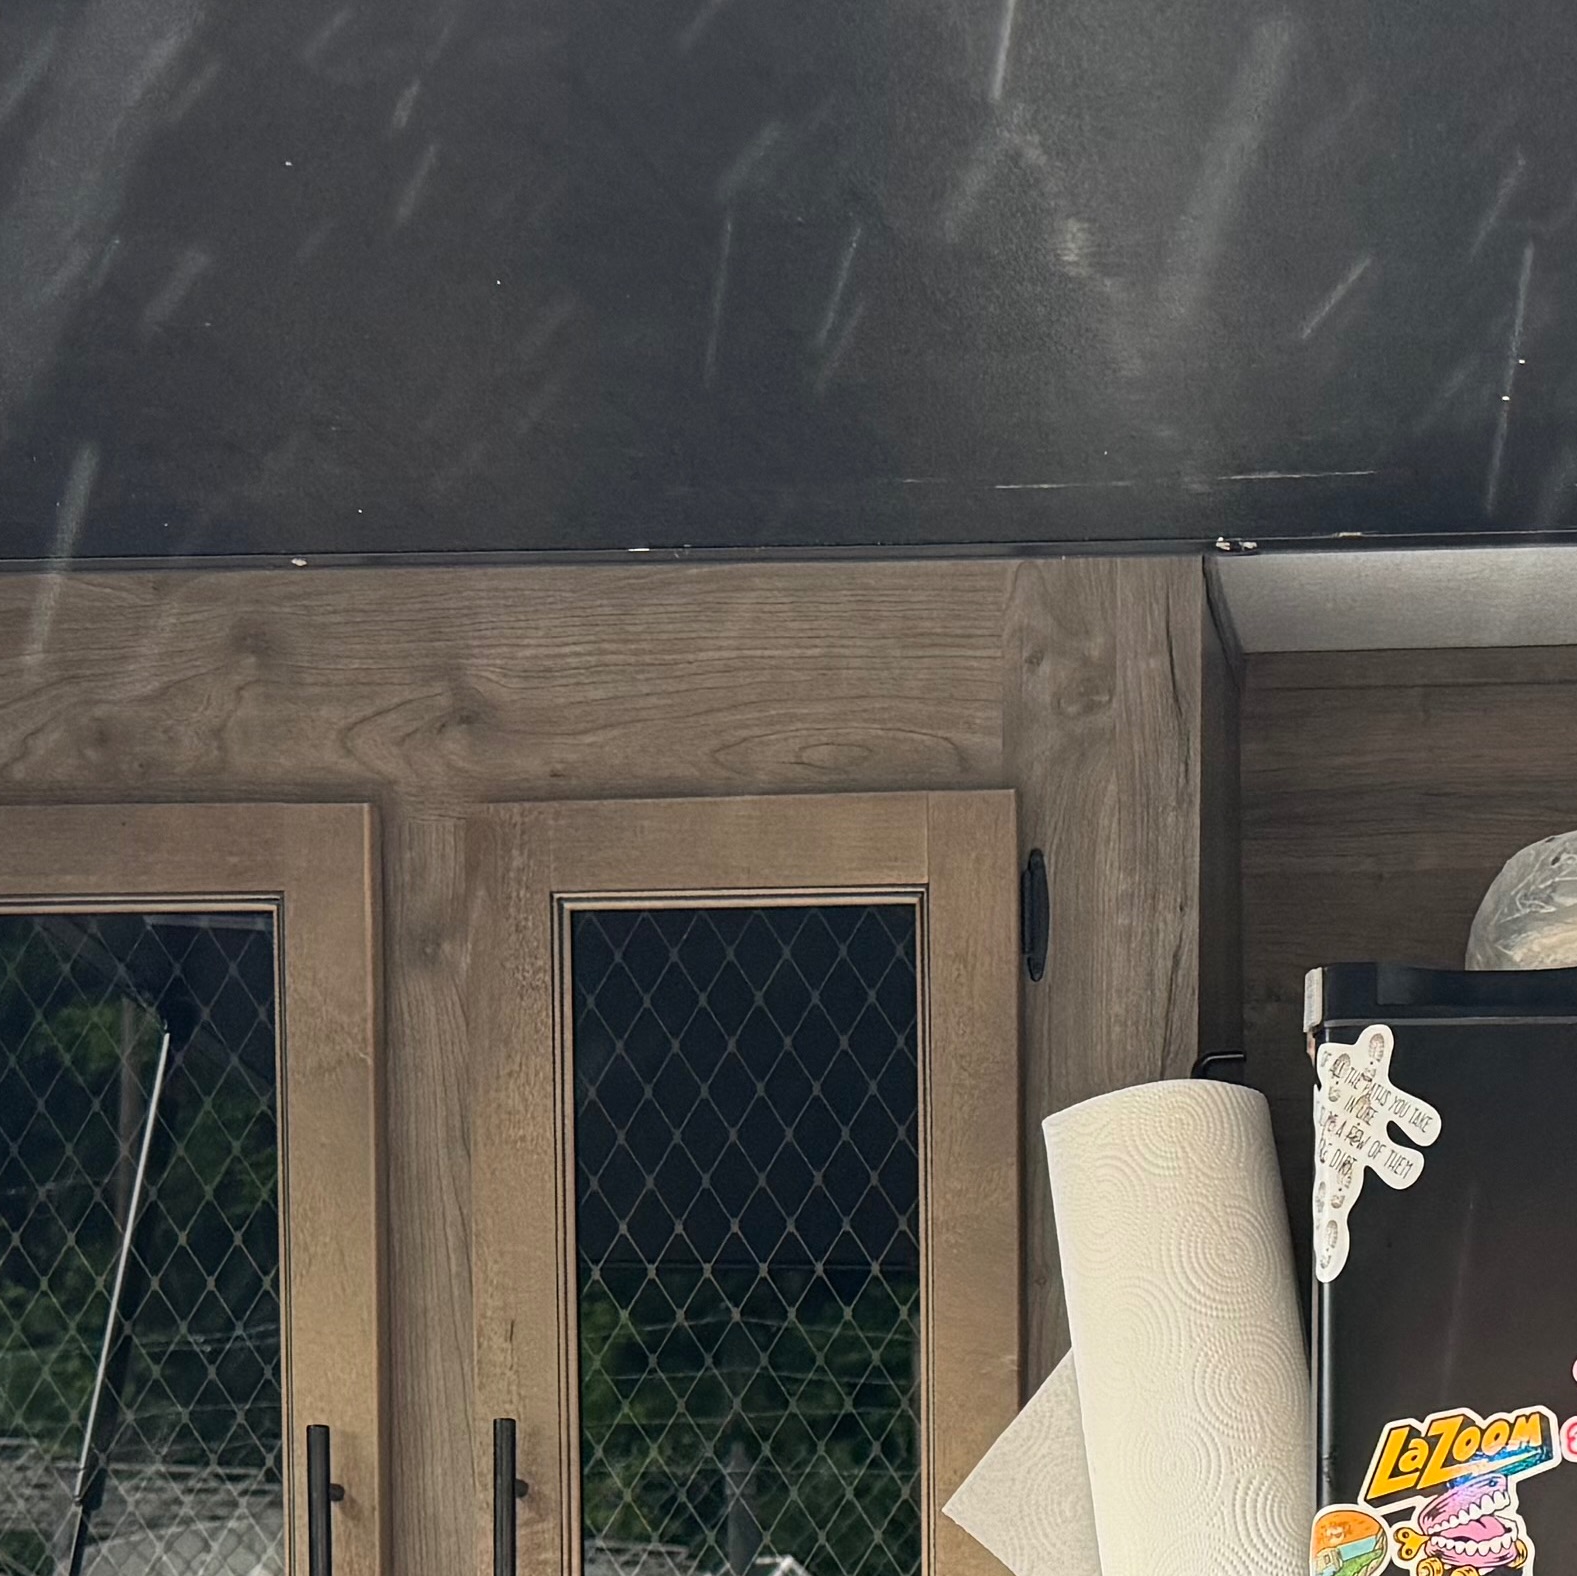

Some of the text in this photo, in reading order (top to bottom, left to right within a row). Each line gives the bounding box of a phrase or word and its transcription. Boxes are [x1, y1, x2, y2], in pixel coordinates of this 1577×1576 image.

[1388, 1094, 1412, 1118] YOU
[1408, 1107, 1434, 1134] TAKE
[1367, 1139, 1387, 1159] OF
[1384, 1149, 1414, 1179] THEM
